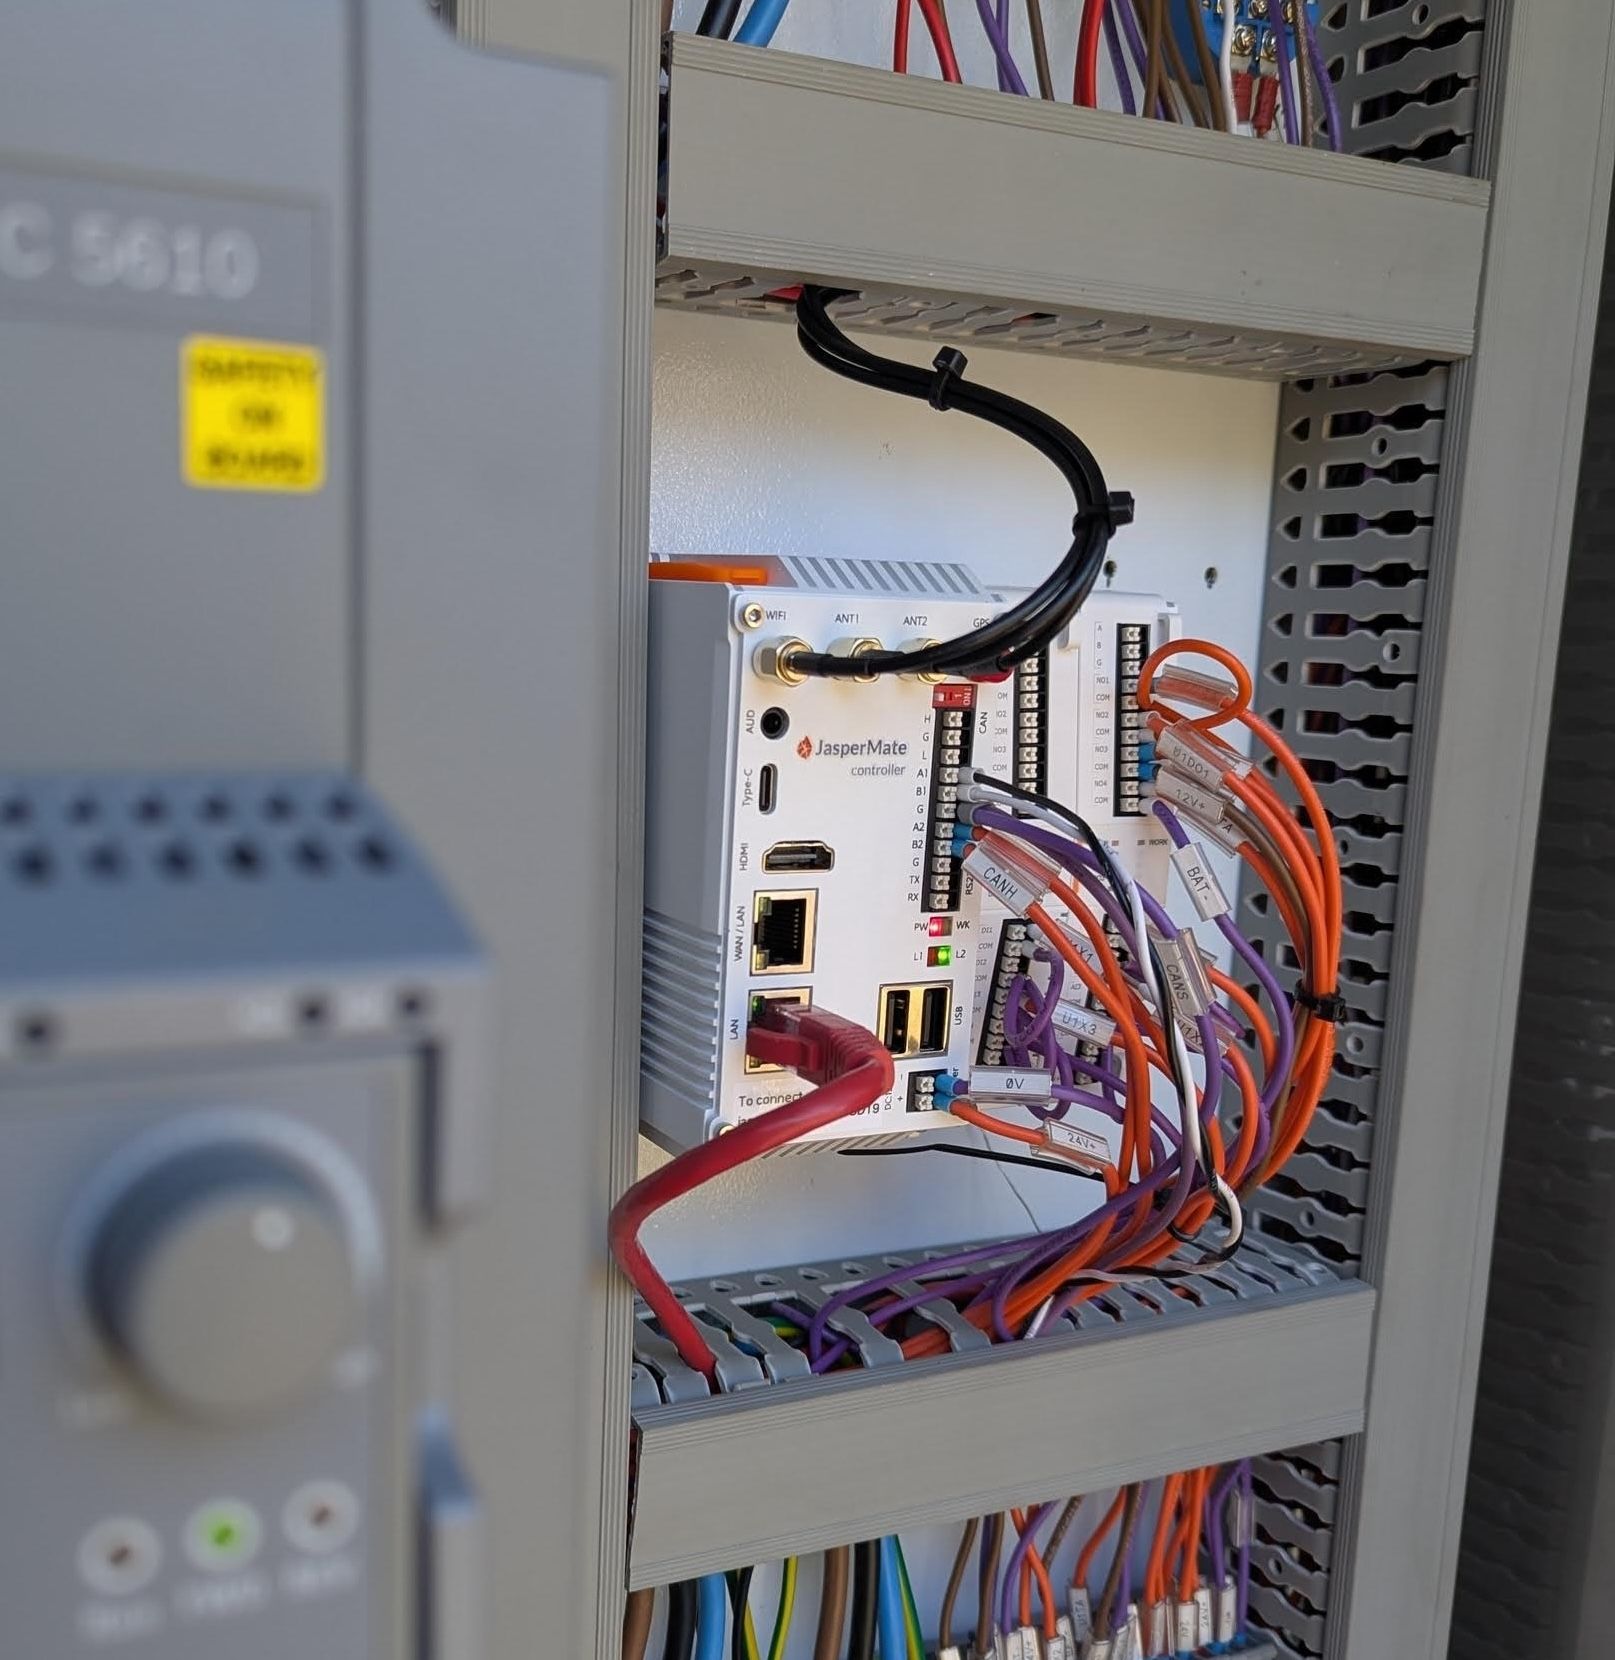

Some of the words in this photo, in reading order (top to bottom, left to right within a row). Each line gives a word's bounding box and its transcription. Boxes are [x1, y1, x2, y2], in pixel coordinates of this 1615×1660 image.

[835, 613, 859, 624] ANT1
[903, 616, 928, 626] ANT2
[973, 617, 990, 628] GPS
[746, 709, 755, 734] AUD
[924, 715, 931, 723] H
[979, 712, 988, 734] CAN
[1096, 728, 1110, 736] COM
[922, 733, 930, 742] G
[815, 739, 907, 758] JasperMate
[922, 751, 927, 760] L
[851, 763, 906, 776] controller
[917, 768, 928, 778] A1
[742, 768, 752, 807] Type-C
[916, 787, 927, 796] B1
[917, 805, 924, 814] G
[912, 822, 925, 832] A2
[912, 840, 923, 849] B2
[740, 842, 749, 871] HDMI
[912, 857, 920, 867] G
[909, 875, 920, 884] TX
[983, 867, 1018, 900] CANH
[908, 892, 919, 901] RX
[736, 906, 745, 926] LAN
[914, 922, 928, 931] PW
[956, 920, 970, 929] WK
[734, 936, 743, 962] WAN
[956, 949, 966, 959] L2
[914, 951, 922, 960] L1
[1167, 964, 1189, 1000] CANS
[954, 1005, 963, 1026] USB
[730, 1019, 738, 1040] LAN
[739, 1096, 753, 1107] To
